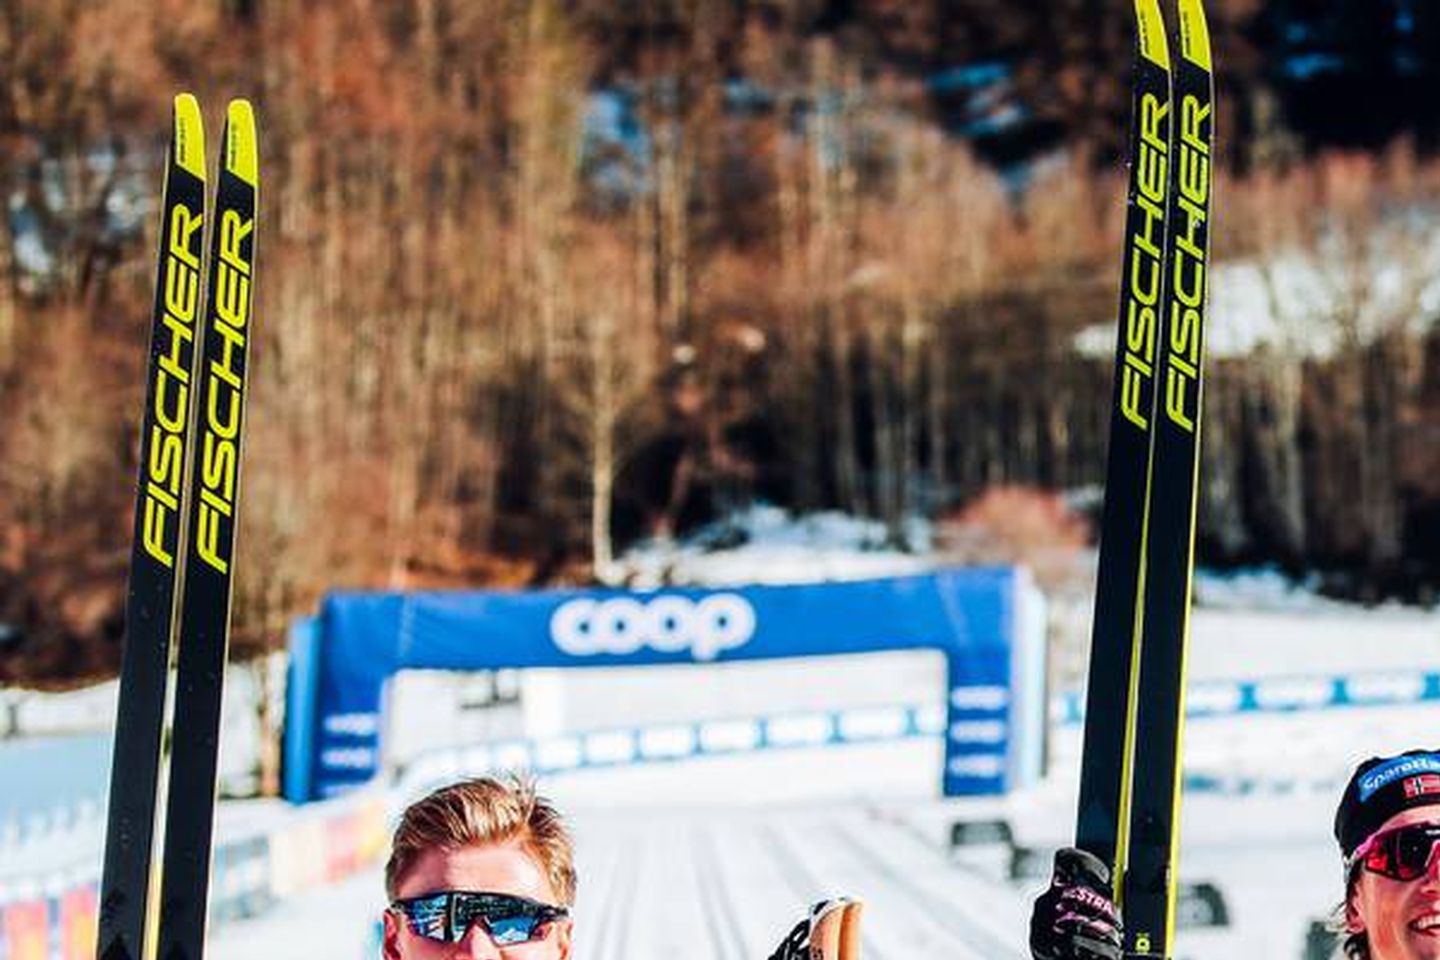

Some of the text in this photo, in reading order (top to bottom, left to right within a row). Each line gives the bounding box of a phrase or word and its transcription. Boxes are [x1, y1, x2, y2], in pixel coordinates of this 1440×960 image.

[142, 203, 205, 568] FISCHER
[196, 209, 255, 574] FISCHER
[1121, 93, 1169, 432] FISCHER
[1166, 94, 1211, 432] FISCHER
[550, 594, 756, 660] coop
